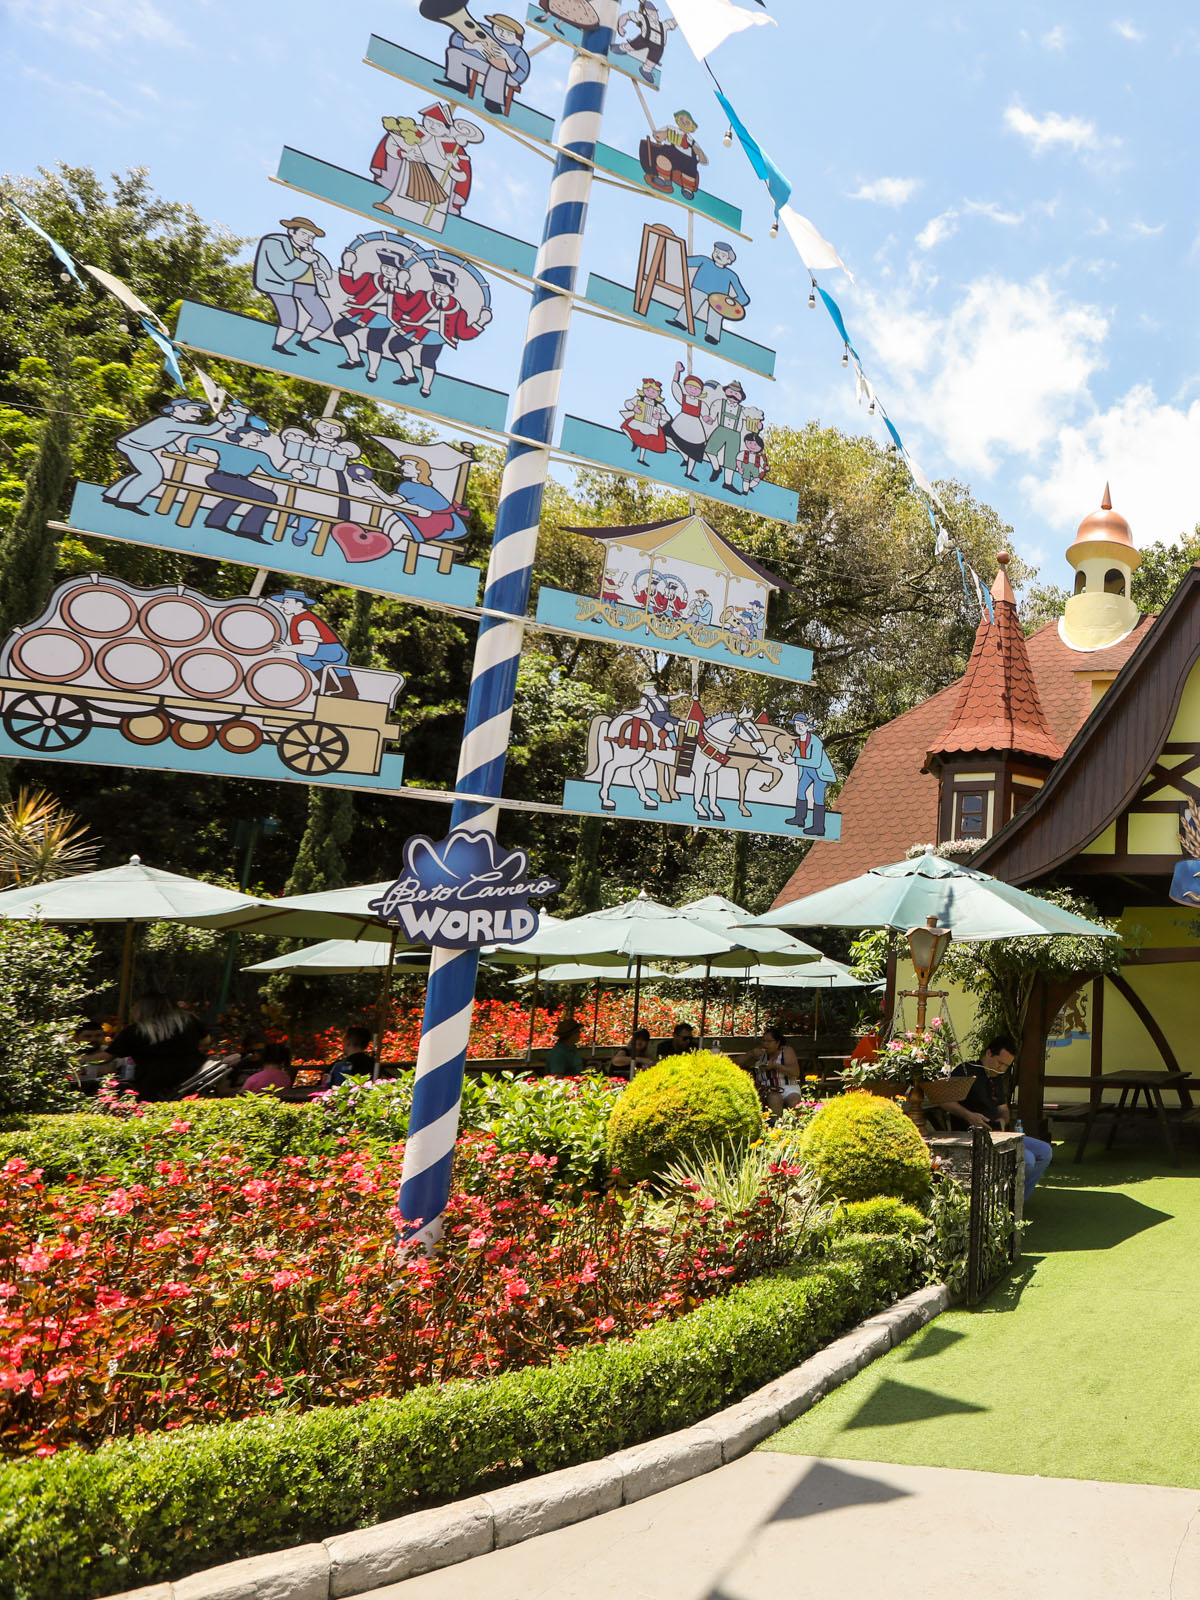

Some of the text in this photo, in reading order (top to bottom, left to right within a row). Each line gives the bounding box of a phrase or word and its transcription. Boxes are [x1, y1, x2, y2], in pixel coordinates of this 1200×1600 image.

[372, 872, 556, 916] Beto Carrero
[398, 903, 535, 942] WORLD
